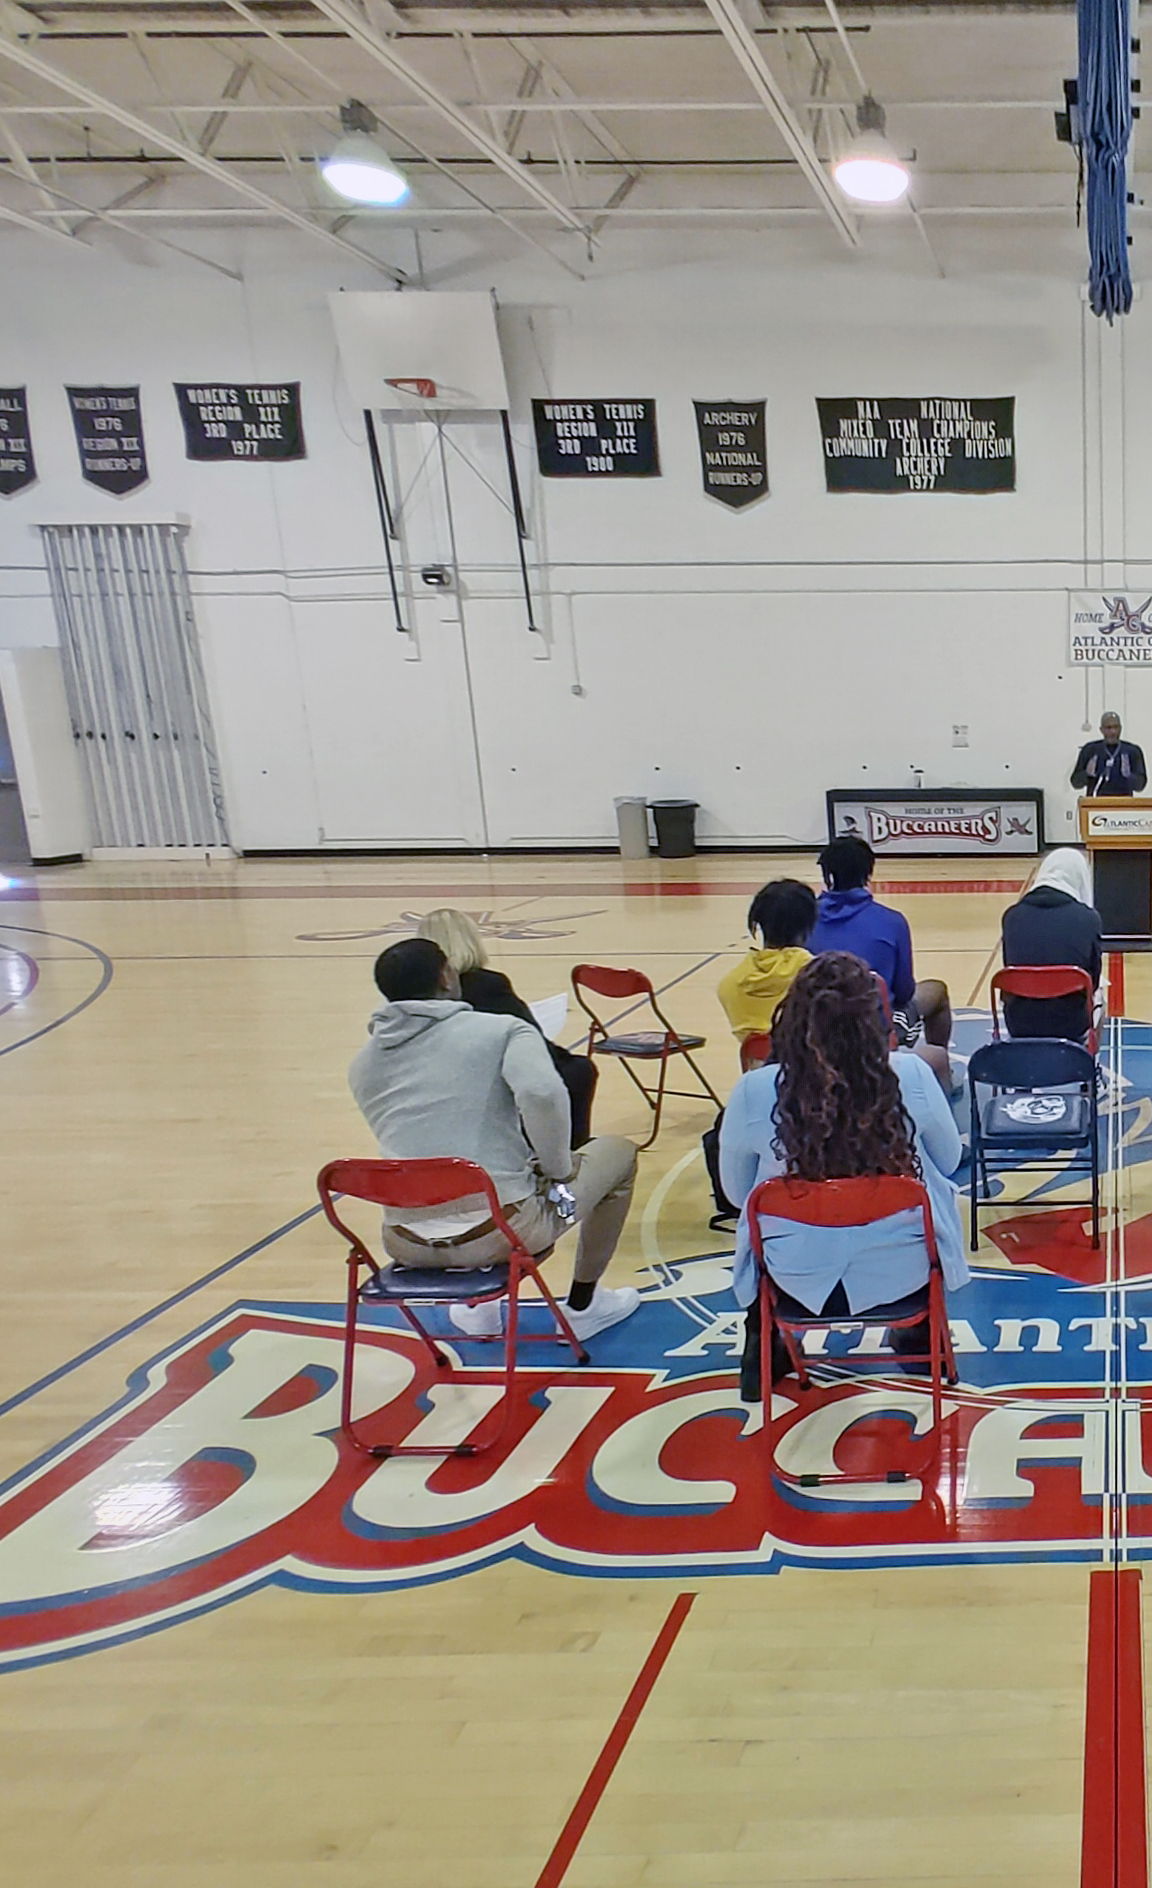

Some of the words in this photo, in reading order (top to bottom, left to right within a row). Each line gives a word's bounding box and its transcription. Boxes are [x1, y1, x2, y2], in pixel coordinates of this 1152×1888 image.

[245, 389, 290, 405] TENNIS
[199, 405, 243, 421] REGION
[258, 406, 281, 422] XIX
[603, 403, 645, 420] TENNIS
[857, 400, 882, 420] NAA
[920, 400, 973, 420] NATIONAL
[703, 411, 757, 426] ARCHERY
[203, 422, 227, 438] 3RD
[243, 423, 283, 439] PLACE
[555, 421, 598, 437] REGION
[614, 421, 636, 437] XIX
[839, 419, 874, 439] MIXED
[887, 419, 919, 439] TEAM
[933, 419, 996, 440] CHAMPIONS
[557, 438, 582, 454] 3RD
[600, 438, 638, 454] PLACE
[717, 431, 746, 446] 1976
[230, 440, 259, 455] 1977
[825, 437, 888, 458] COMMUNITY
[902, 438, 952, 458] COLLEGE
[965, 438, 1012, 459] DIVISION
[585, 455, 615, 472] 1980
[705, 451, 762, 467] NATIONAL
[895, 457, 946, 476] ARCHERY
[908, 475, 936, 490] 1977
[1074, 612, 1105, 623] HOME
[1072, 635, 1144, 647] ATLANTIC
[868, 809, 998, 842] BUCCANEERS
